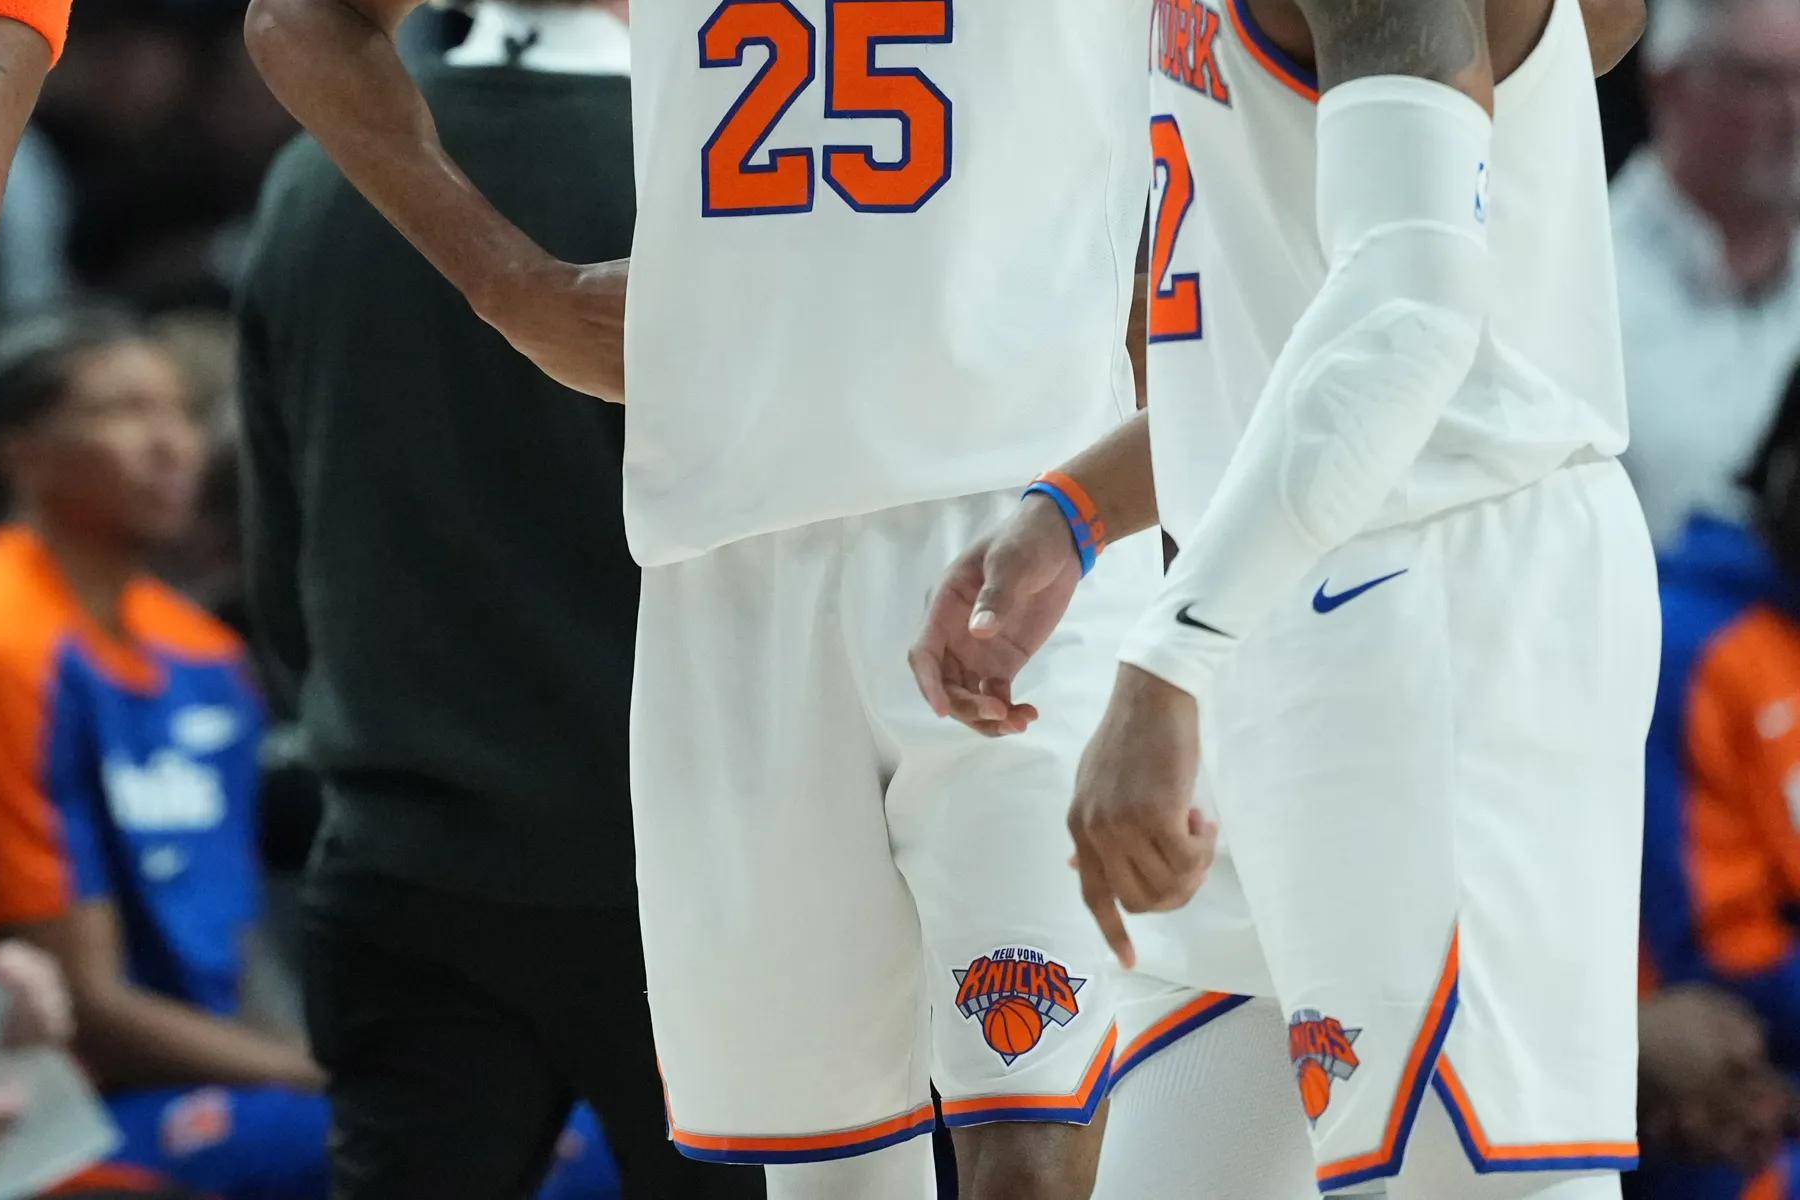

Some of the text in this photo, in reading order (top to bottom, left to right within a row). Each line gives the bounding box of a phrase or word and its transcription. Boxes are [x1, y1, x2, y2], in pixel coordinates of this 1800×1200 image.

[1149, 114, 1203, 345] 2
[955, 955, 1080, 1017] KNICKS
[991, 947, 1045, 964] NEW YORK
